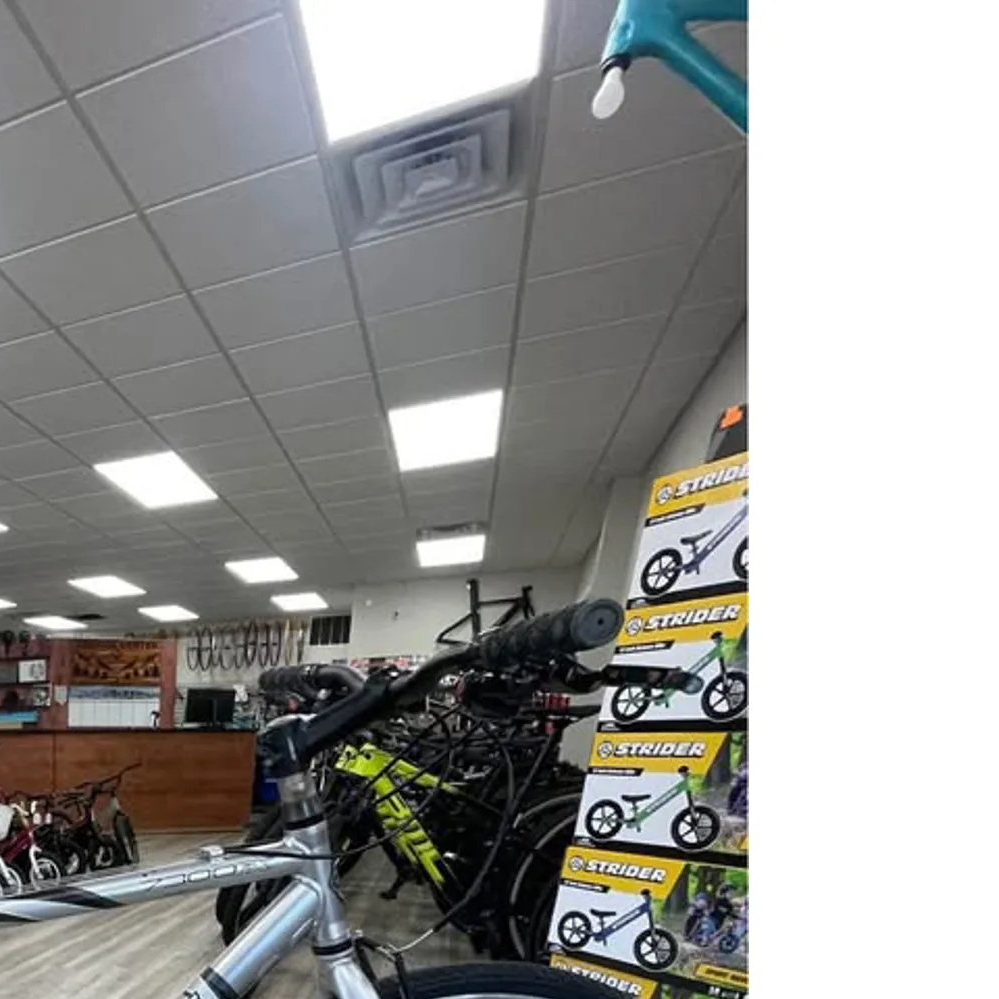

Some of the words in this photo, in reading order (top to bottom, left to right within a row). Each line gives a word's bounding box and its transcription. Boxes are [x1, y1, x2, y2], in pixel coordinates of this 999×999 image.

[645, 604, 741, 631] STRIDER
[614, 741, 706, 758] STRIDER
[584, 858, 667, 882] STRIDER
